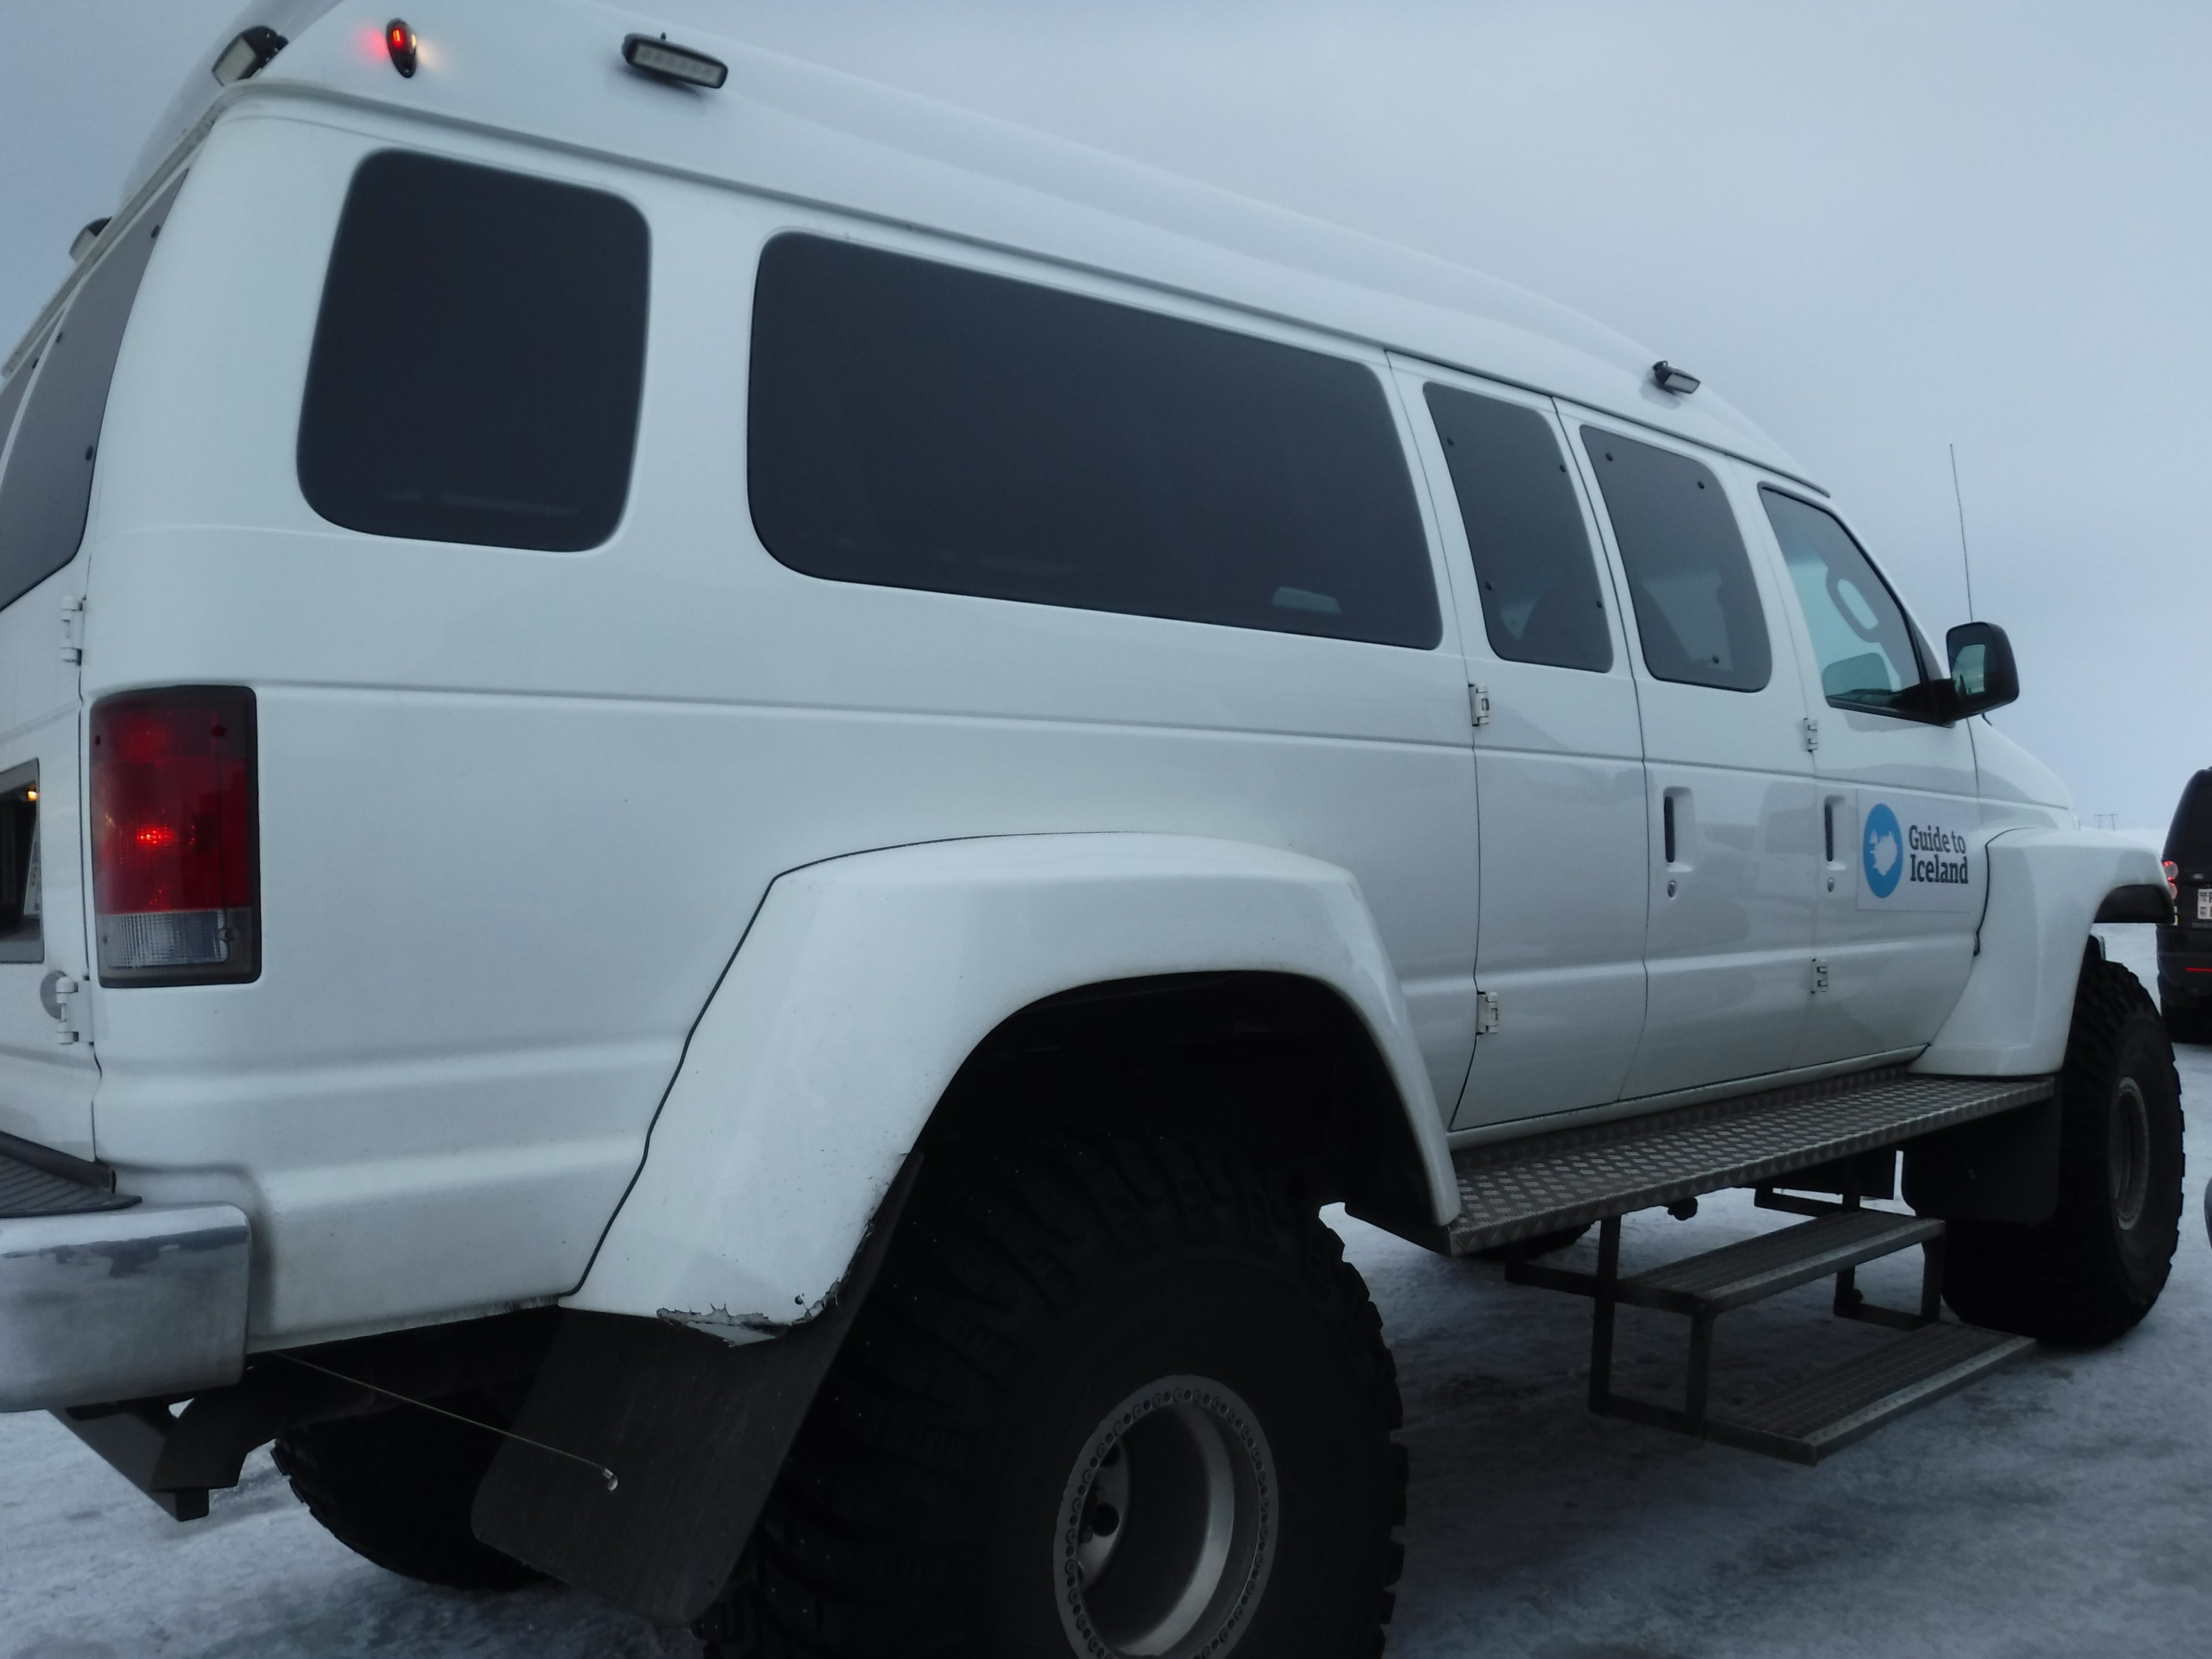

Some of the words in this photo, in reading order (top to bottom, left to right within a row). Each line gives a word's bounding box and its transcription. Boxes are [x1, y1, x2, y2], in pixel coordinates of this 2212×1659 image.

[1909, 825, 1950, 853] Guide
[1951, 831, 1966, 854] to
[1910, 854, 1968, 884] Iceland
